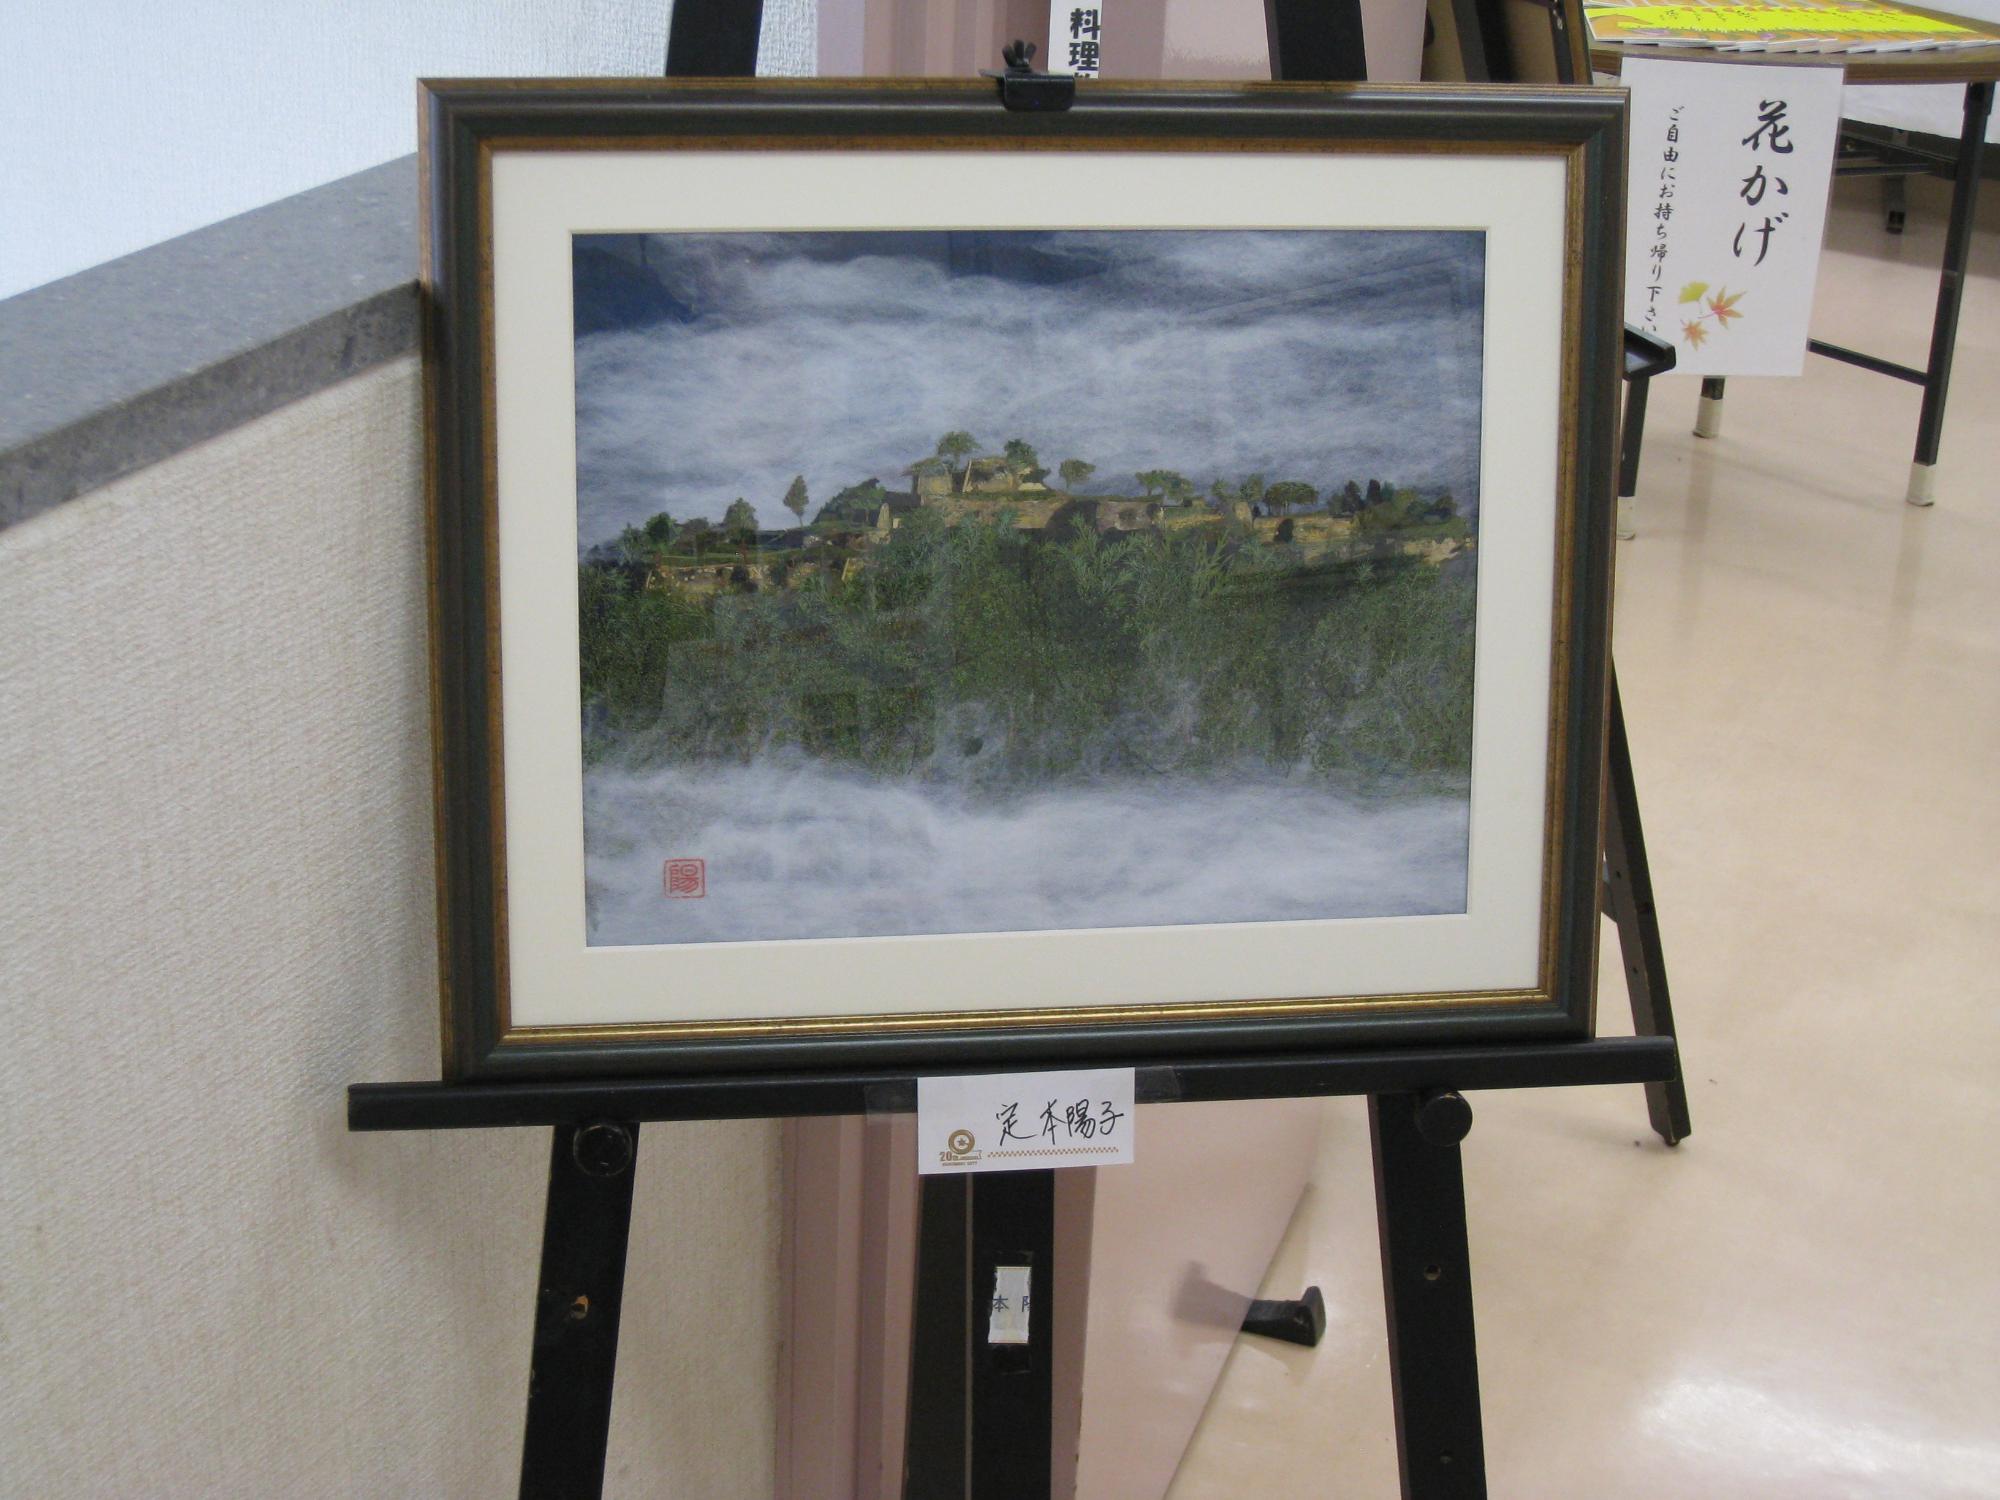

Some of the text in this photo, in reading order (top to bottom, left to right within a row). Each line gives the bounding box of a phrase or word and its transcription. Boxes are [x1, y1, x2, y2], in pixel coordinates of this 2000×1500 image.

[1066, 8, 1101, 77] 料理
[1733, 99, 1794, 267] 花かげ
